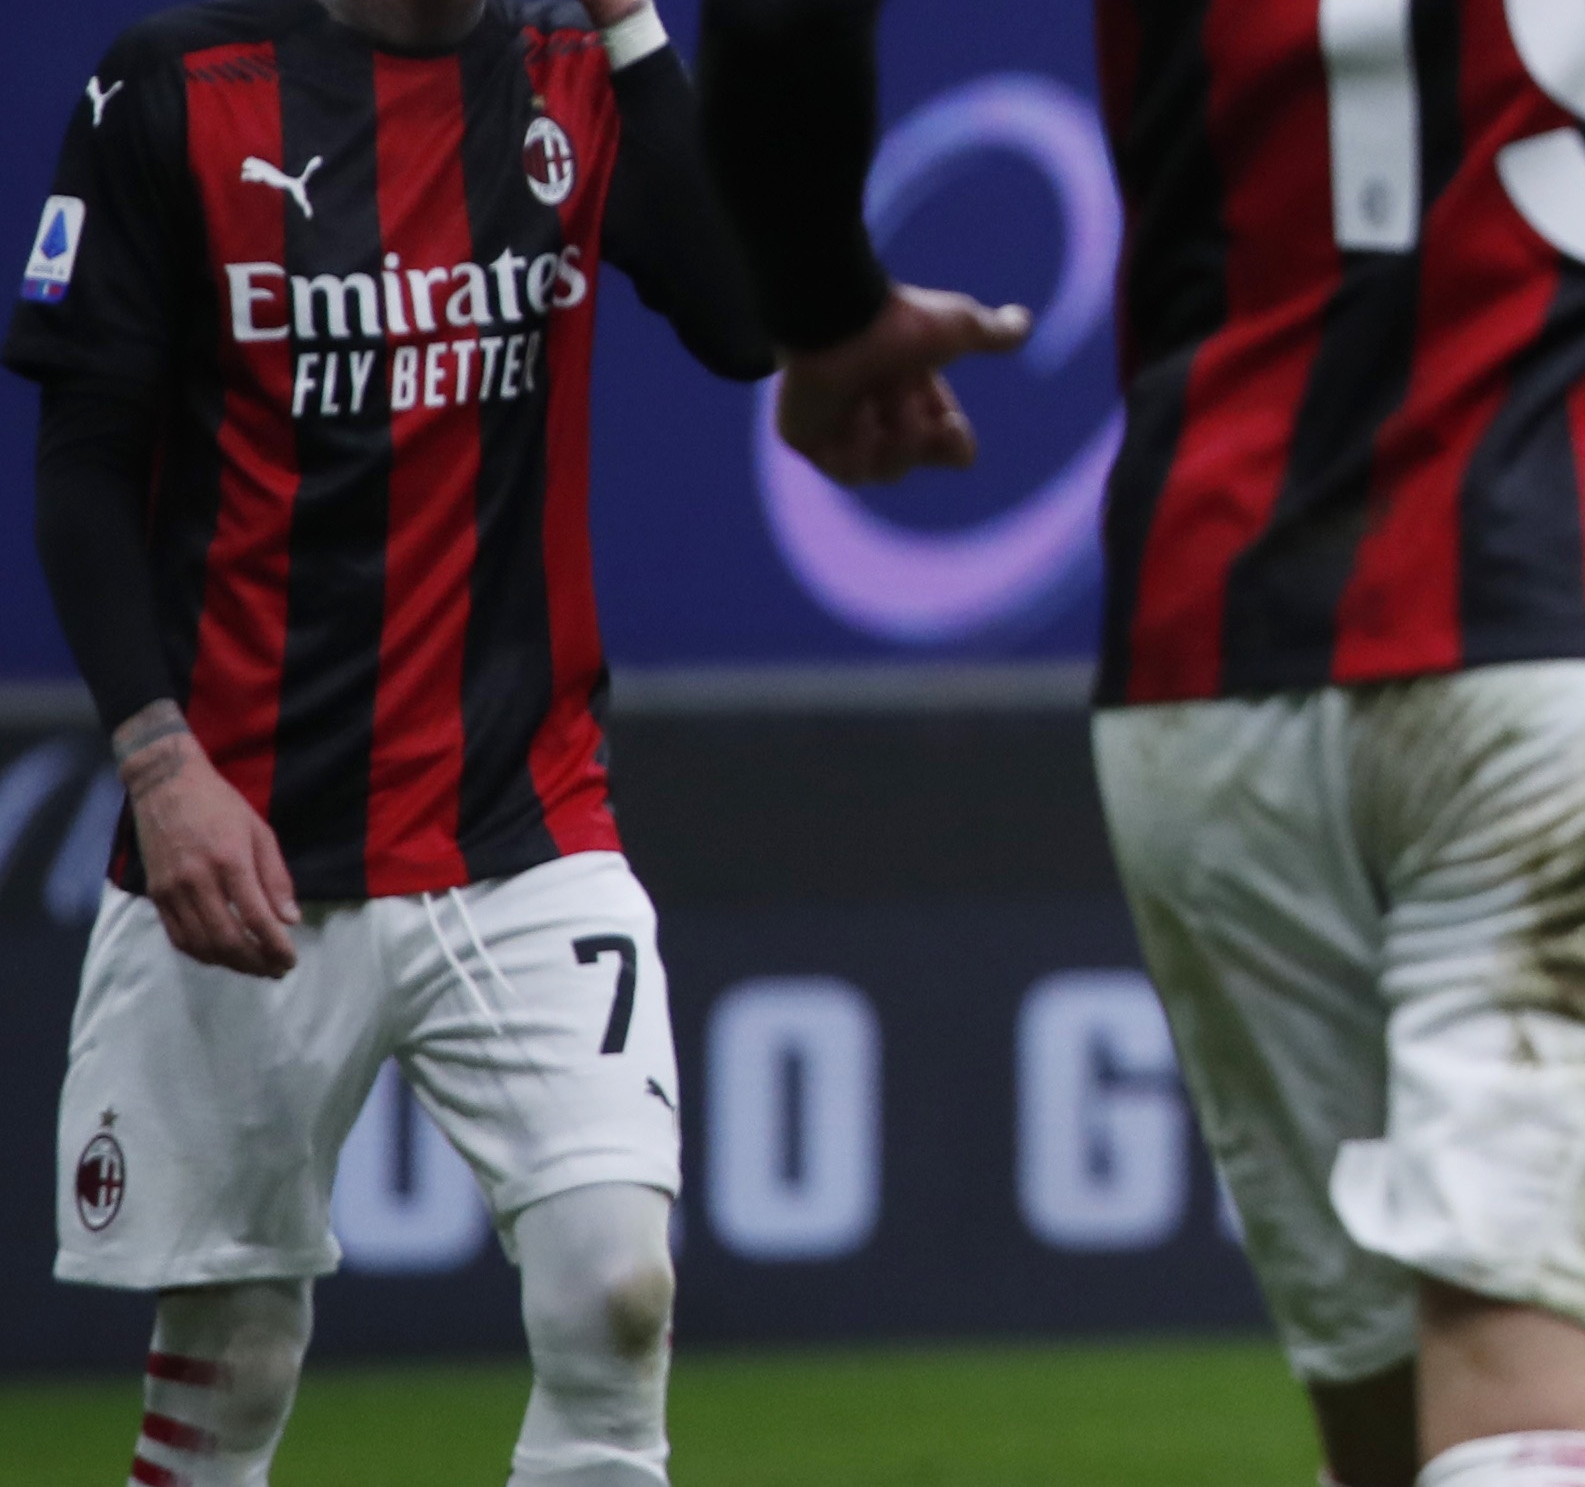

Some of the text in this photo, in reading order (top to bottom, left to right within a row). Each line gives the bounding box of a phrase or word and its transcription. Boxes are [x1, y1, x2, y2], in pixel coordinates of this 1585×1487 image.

[224, 244, 588, 343] Emirates
[291, 328, 541, 418] FLY BETTER
[570, 932, 638, 1055] 7
